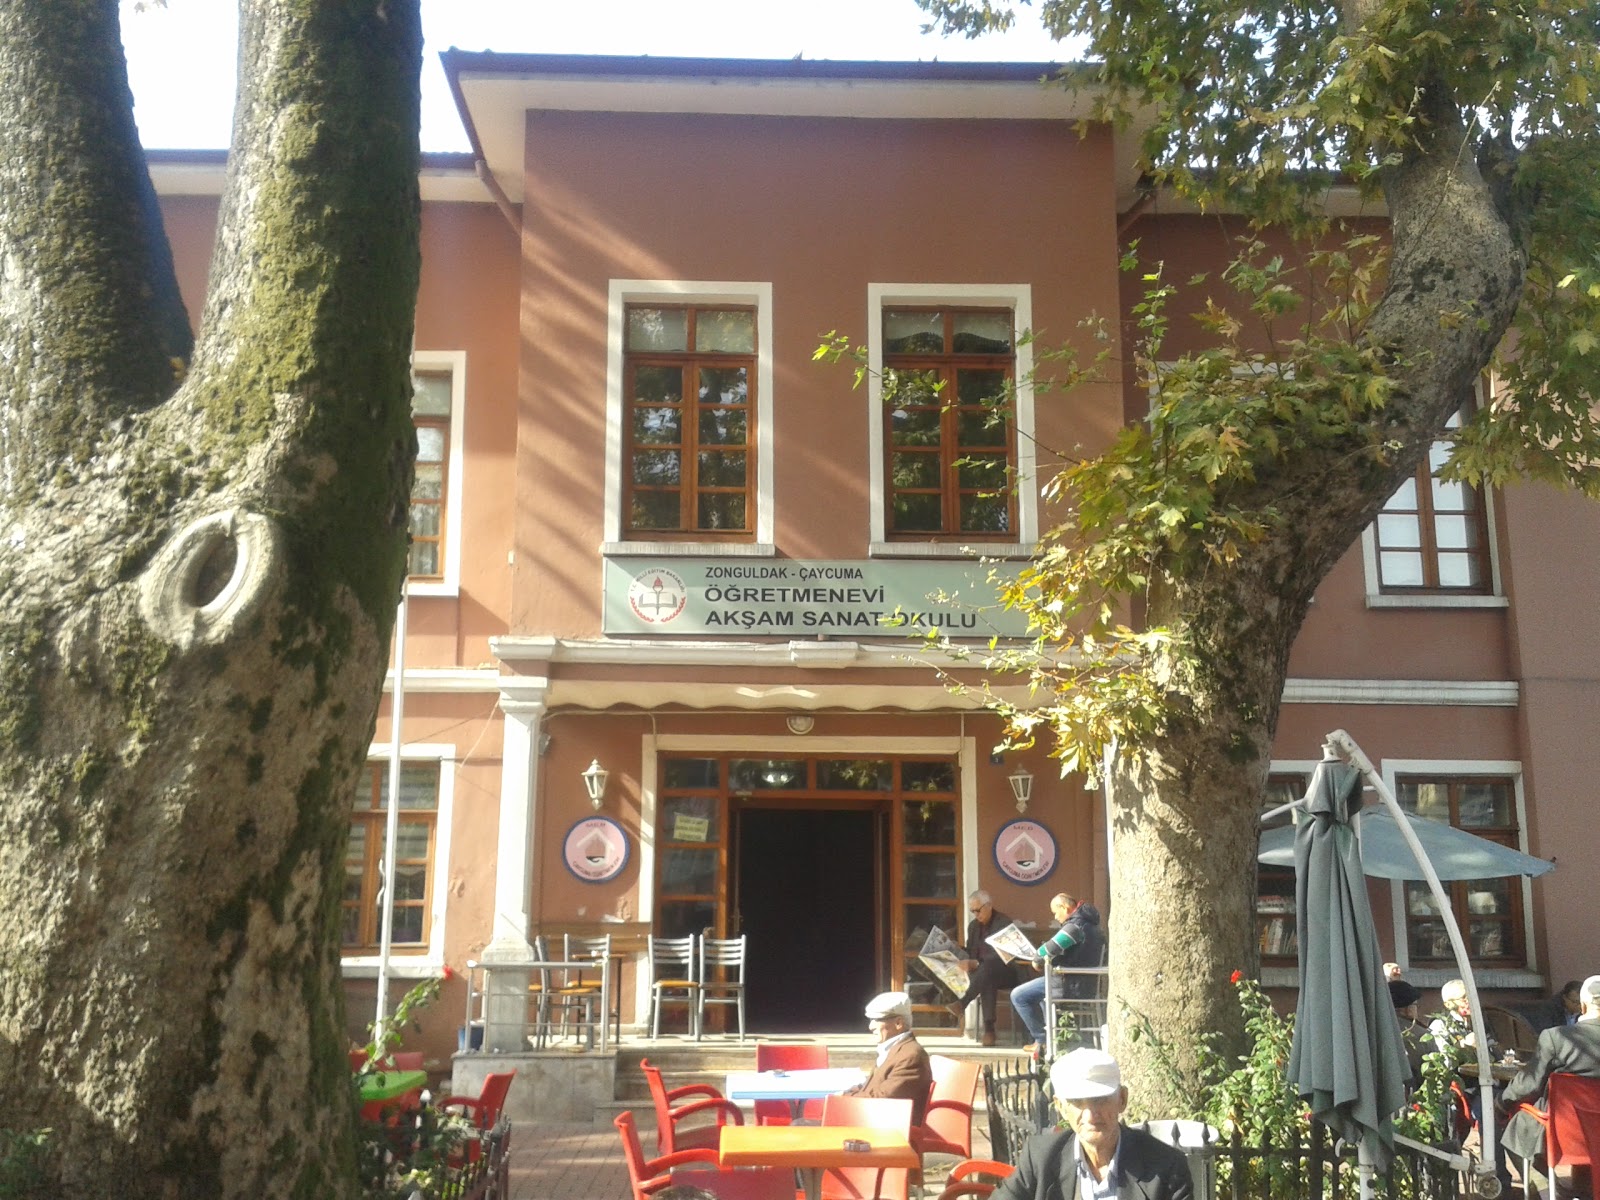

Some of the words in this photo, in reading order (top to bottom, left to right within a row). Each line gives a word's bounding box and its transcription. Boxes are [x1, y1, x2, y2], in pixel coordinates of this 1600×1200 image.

[705, 567, 787, 579] ZONGULDAK
[799, 568, 864, 582] ÇAYCUMA
[704, 585, 884, 603] ÖĞRETMENEVİ
[705, 610, 794, 629] AKŞAM
[802, 611, 883, 626] SANAT
[891, 611, 976, 628] OKULU
